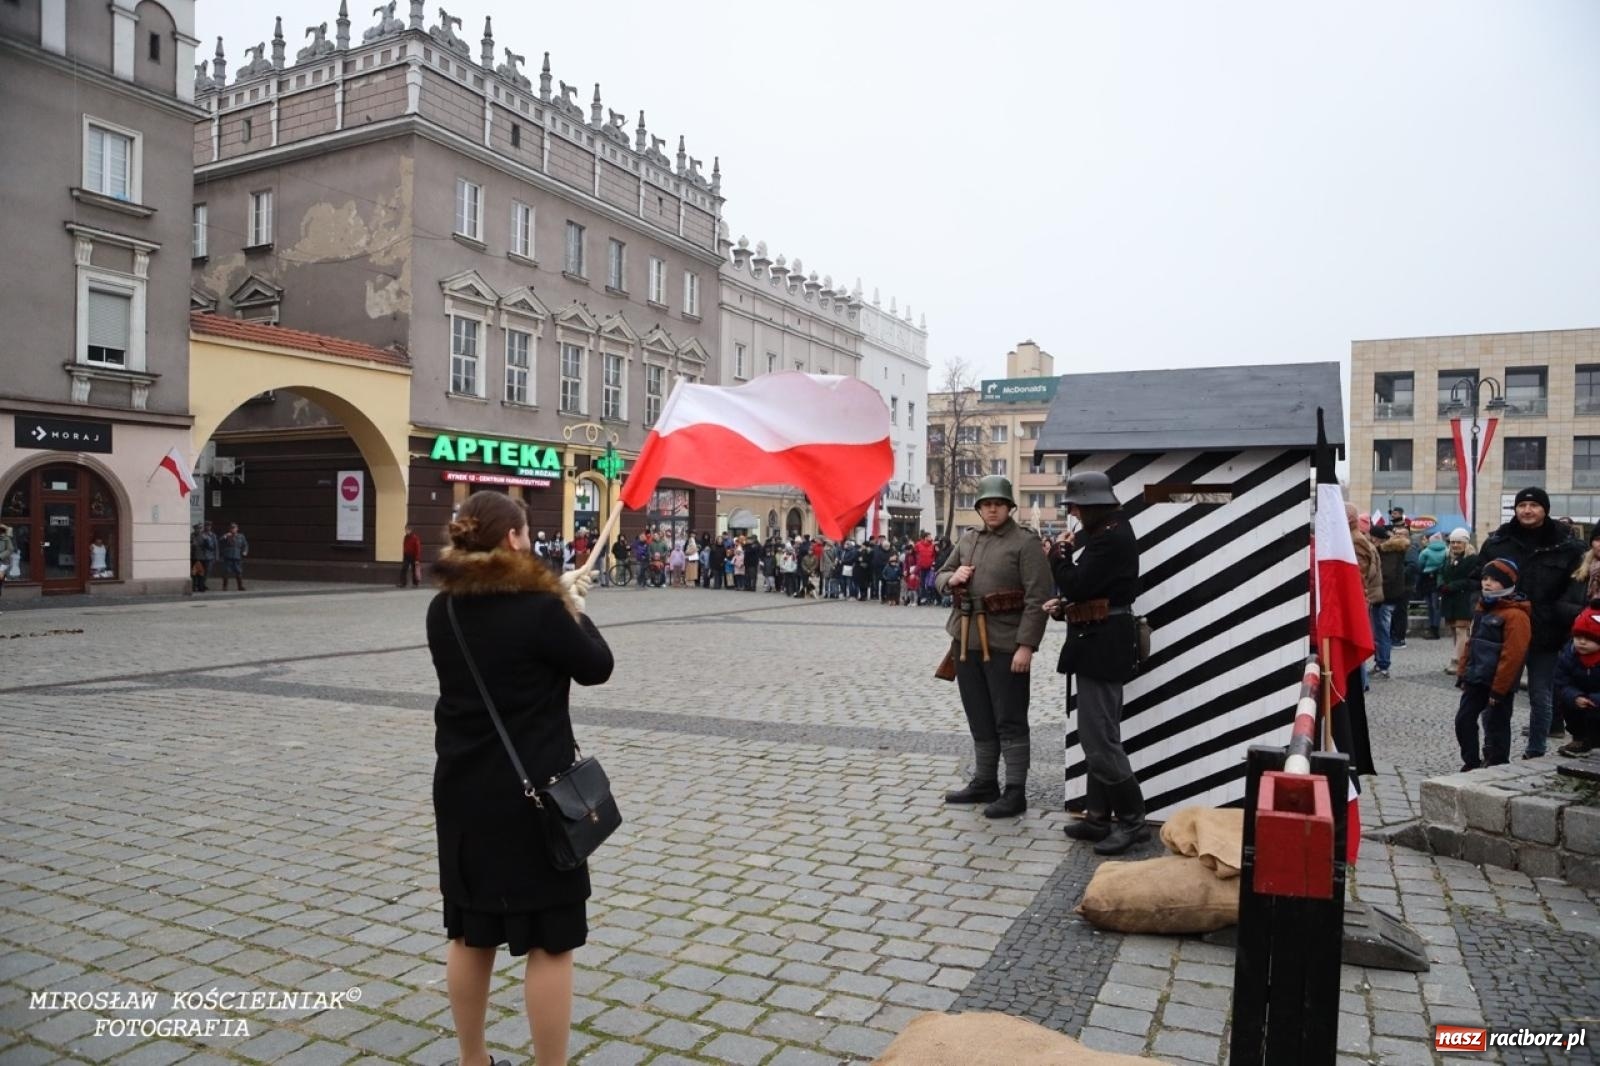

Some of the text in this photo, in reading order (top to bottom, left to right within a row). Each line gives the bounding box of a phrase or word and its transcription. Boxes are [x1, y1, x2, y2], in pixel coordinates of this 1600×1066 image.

[1003, 384, 1046, 393] McDonald's
[51, 431, 100, 442] MORAJ
[430, 434, 561, 470] APTEKA
[447, 473, 467, 481] RYNEK
[479, 475, 505, 484] CENTRUM
